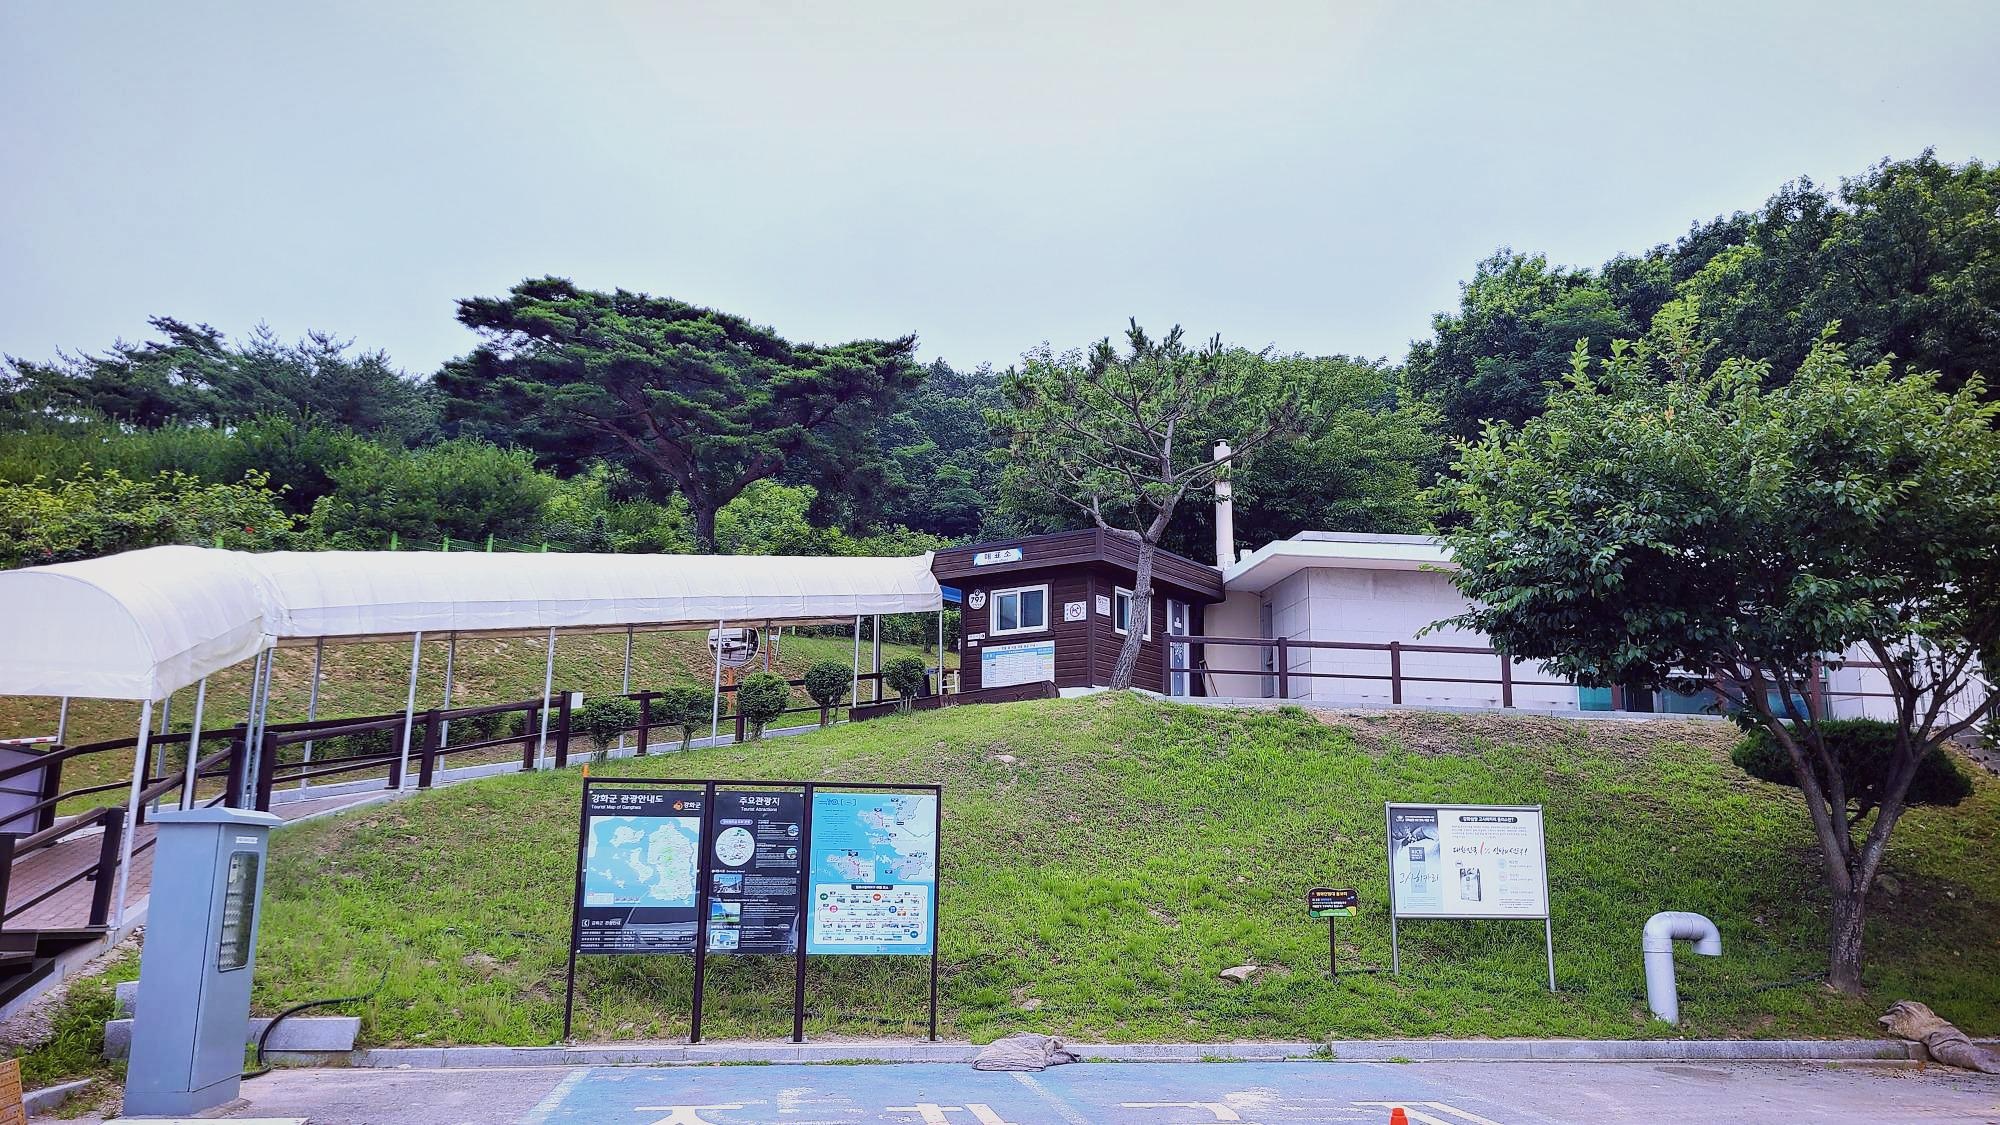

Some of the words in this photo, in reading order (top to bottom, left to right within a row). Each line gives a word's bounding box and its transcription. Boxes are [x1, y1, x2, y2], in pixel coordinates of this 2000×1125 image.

[971, 595, 984, 604] 797
[591, 794, 618, 803] 강화군
[620, 794, 664, 804] 관광안내도
[739, 796, 780, 806] 주요관광지
[684, 801, 701, 809] 강화군
